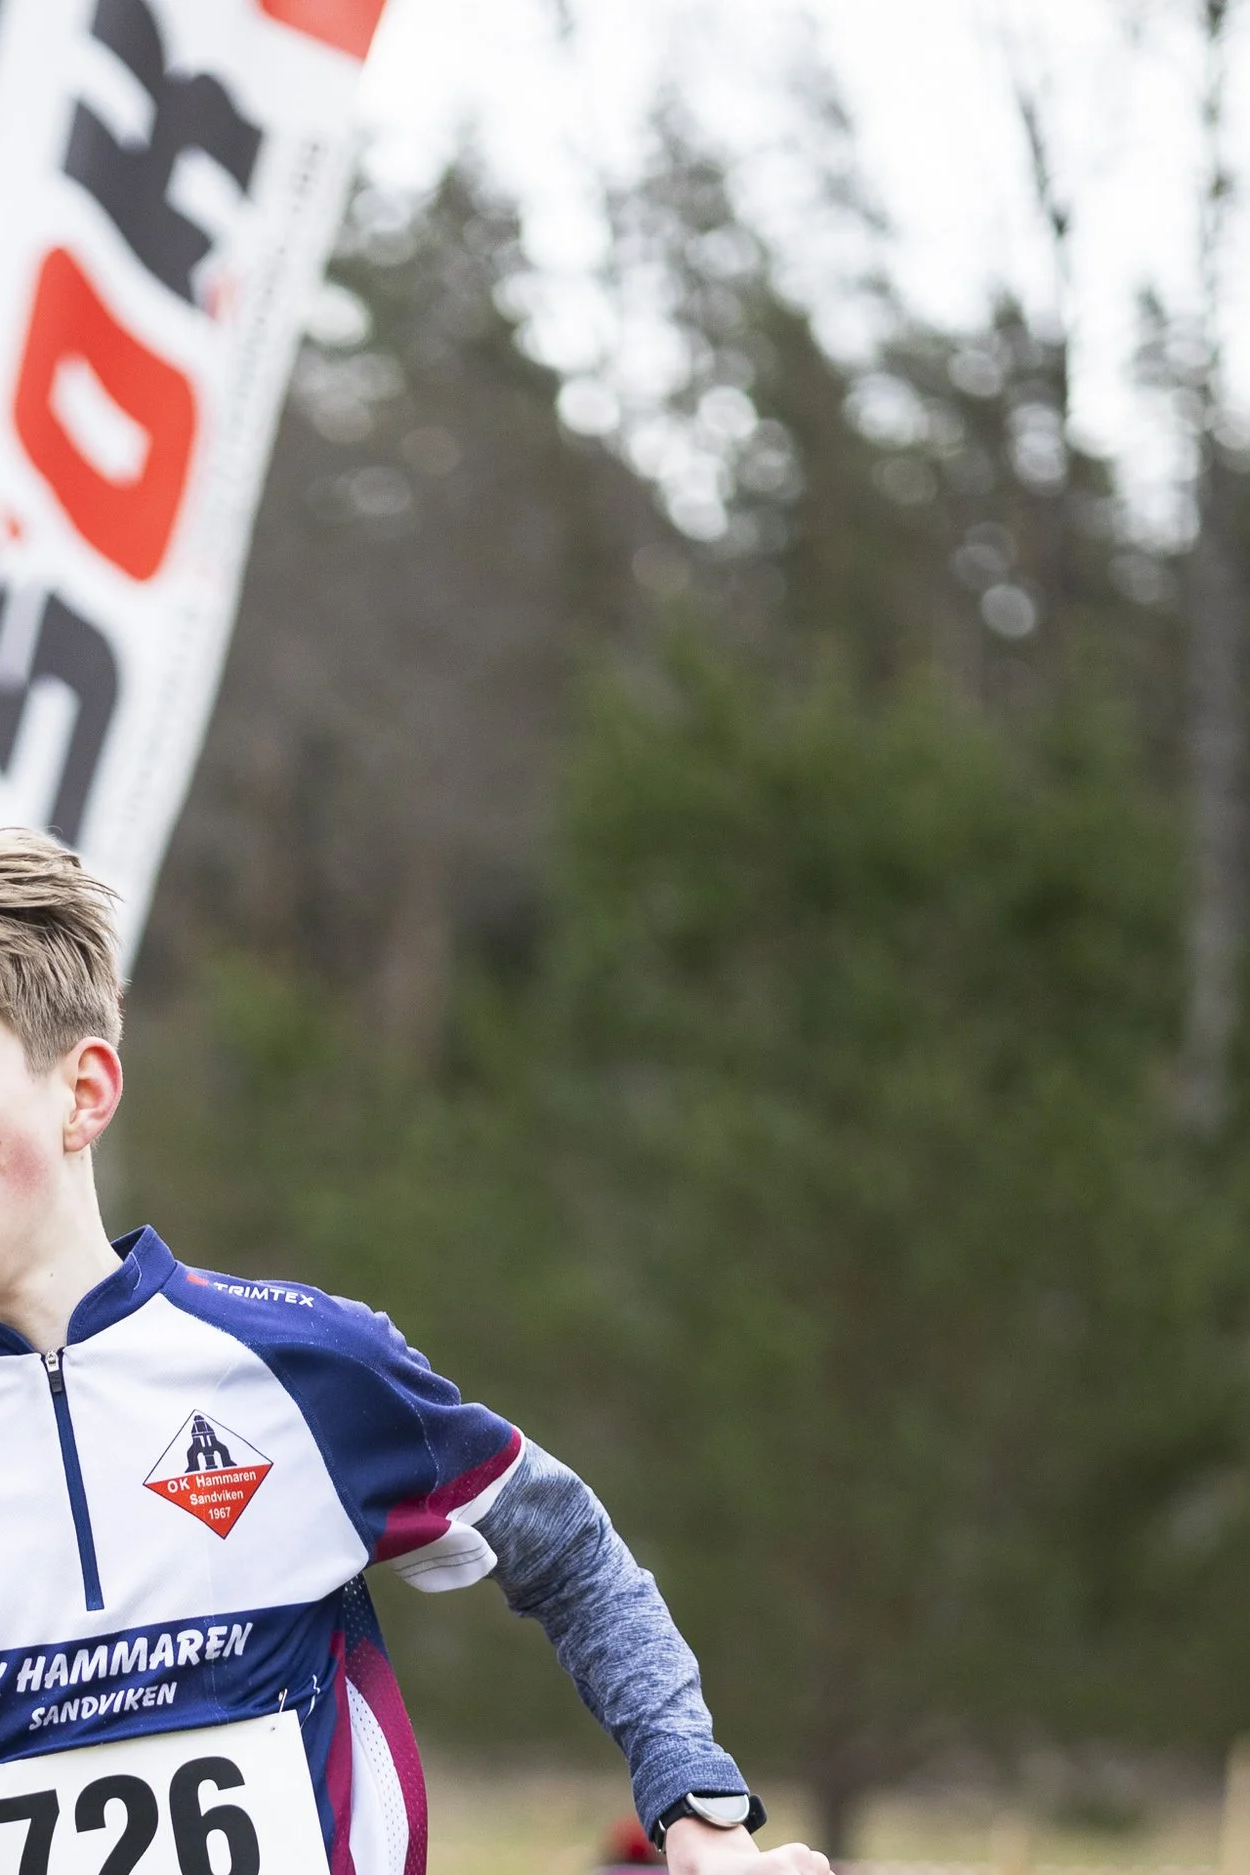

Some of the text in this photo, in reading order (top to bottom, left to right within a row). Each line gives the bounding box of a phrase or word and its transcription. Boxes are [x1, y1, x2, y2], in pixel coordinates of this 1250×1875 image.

[212, 1281, 315, 1308] TRIMTEX
[167, 1470, 257, 1493] OK Hammaren
[189, 1489, 244, 1506] Sandviken
[208, 1506, 231, 1520] 1967
[16, 1622, 254, 1694] HAMMAREN
[28, 1681, 177, 1732] SANDVIKEN
